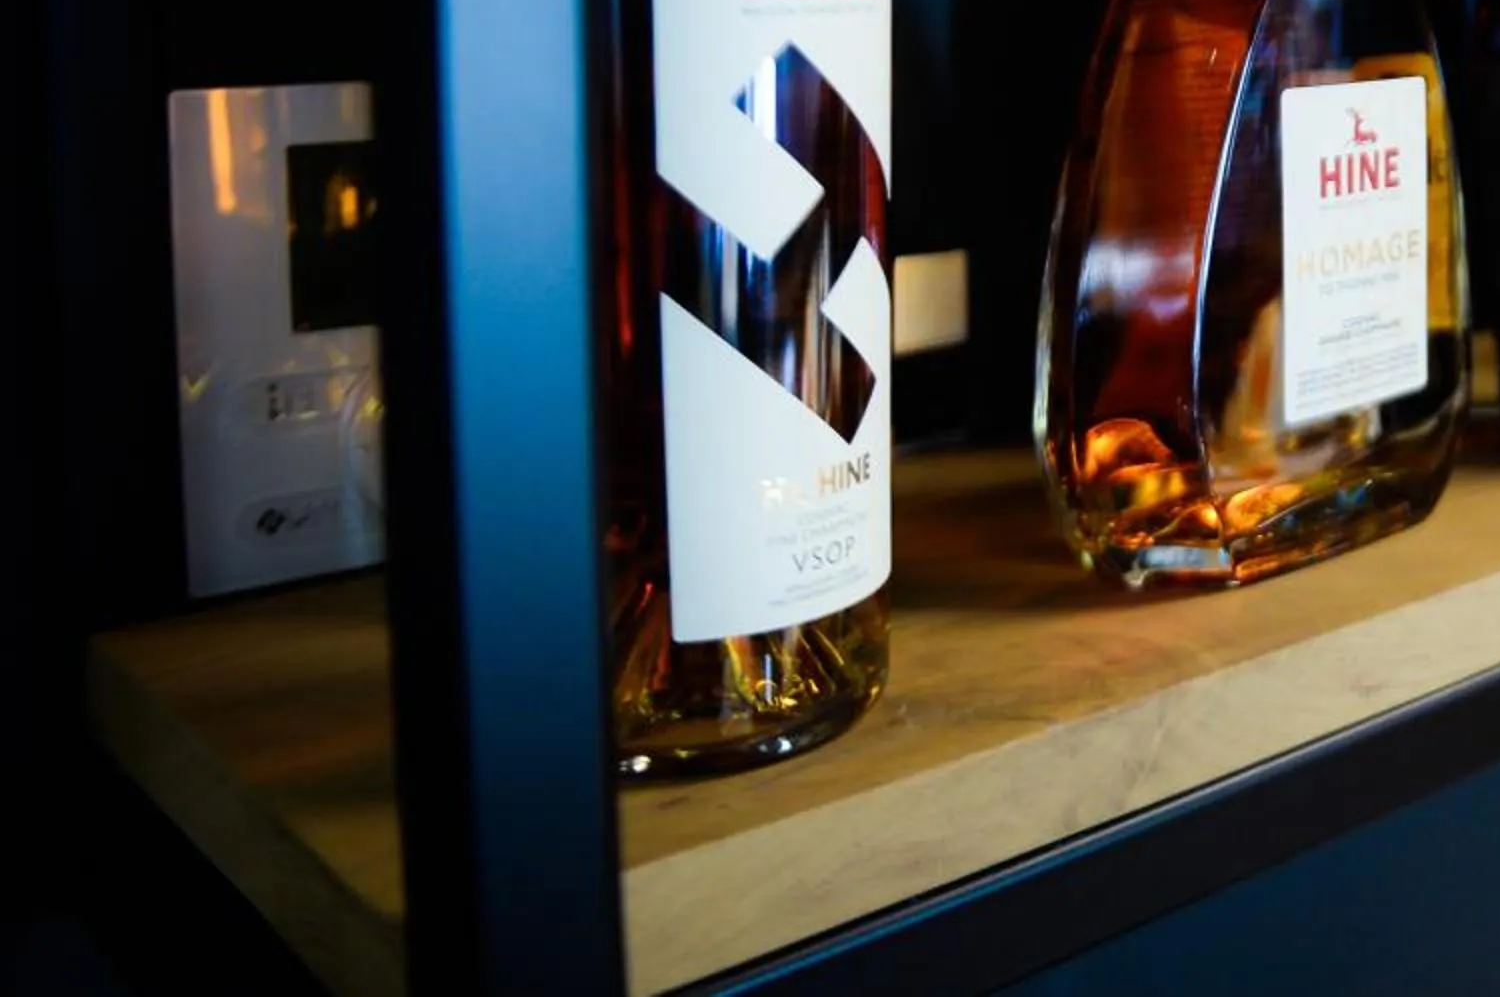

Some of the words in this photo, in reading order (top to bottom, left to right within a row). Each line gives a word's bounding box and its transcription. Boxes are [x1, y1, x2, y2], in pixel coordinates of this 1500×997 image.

[1319, 147, 1401, 199] HINE
[1296, 229, 1421, 281] HOMAGE
[818, 451, 871, 496] HINE
[791, 535, 856, 573] VSOP
